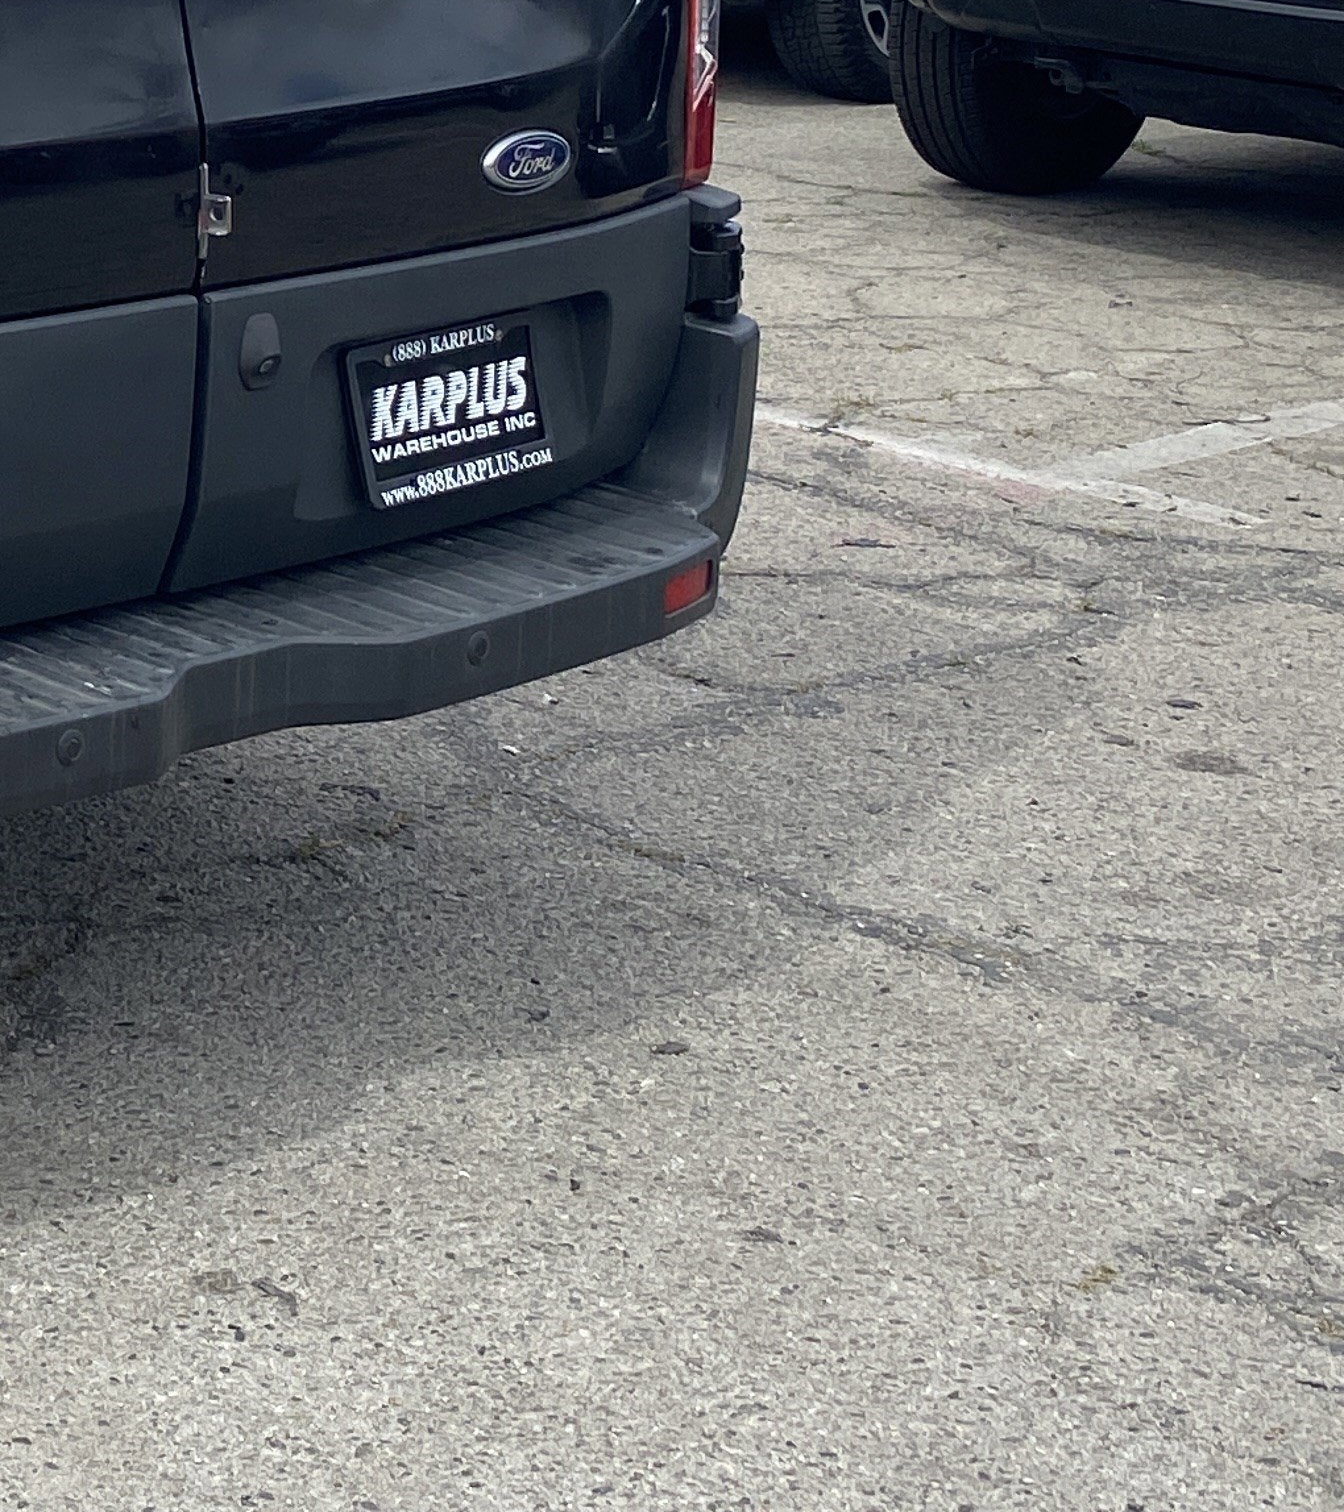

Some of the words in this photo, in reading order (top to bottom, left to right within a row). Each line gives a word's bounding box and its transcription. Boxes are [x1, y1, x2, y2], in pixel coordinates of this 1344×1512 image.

[508, 142, 556, 178] Ford
[392, 340, 426, 362] (888)
[430, 323, 495, 355] KARPLUS
[369, 356, 527, 442] KARPLUS
[371, 420, 501, 464] WAREHOUSE
[504, 411, 537, 432] INC
